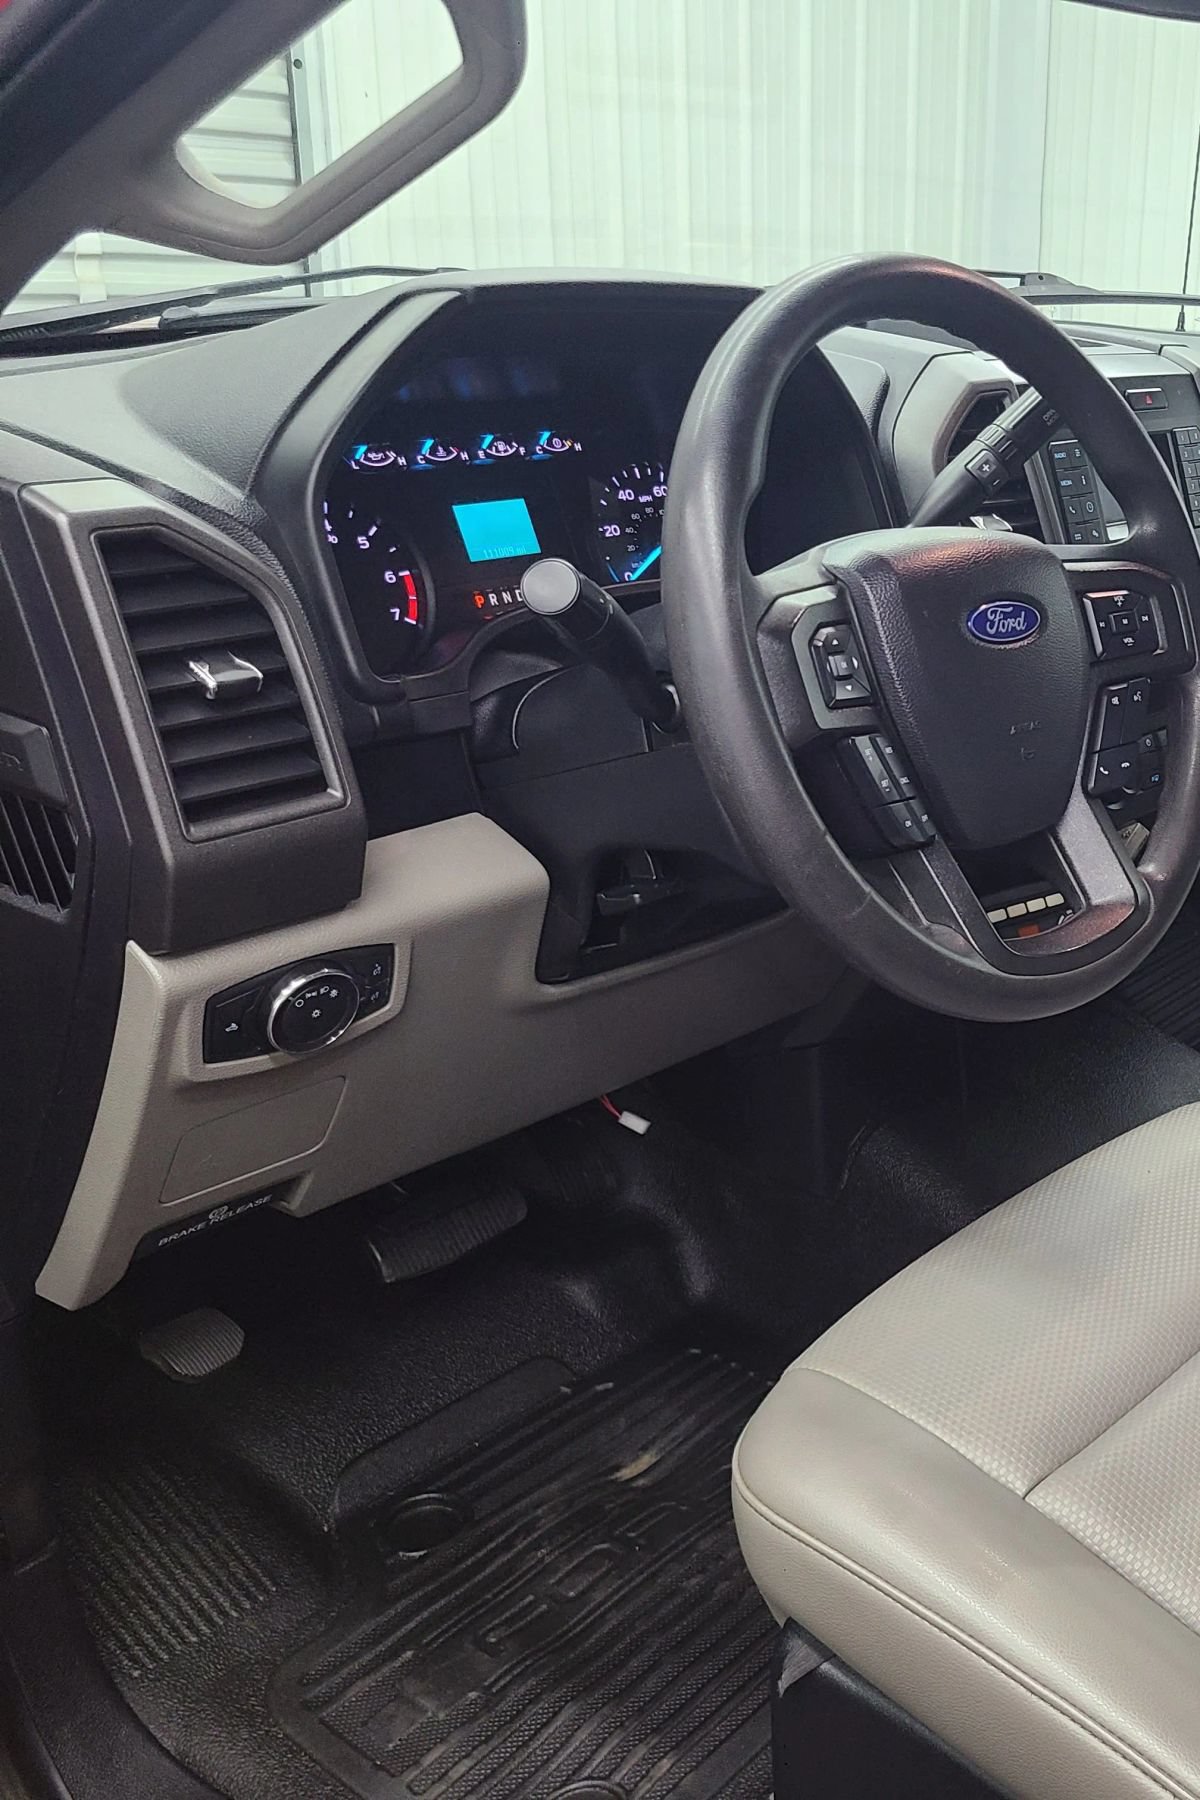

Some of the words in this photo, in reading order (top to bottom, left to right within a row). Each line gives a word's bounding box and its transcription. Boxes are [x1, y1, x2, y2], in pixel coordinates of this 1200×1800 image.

[618, 489, 635, 501] 40
[638, 495, 653, 503] MPH
[603, 524, 620, 537] 20
[357, 536, 370, 549] 5
[384, 571, 397, 583] 6
[389, 608, 401, 620] 7
[986, 606, 1027, 635] Ford
[158, 1221, 208, 1247] BRAKE
[209, 1194, 273, 1225] RELEASE
